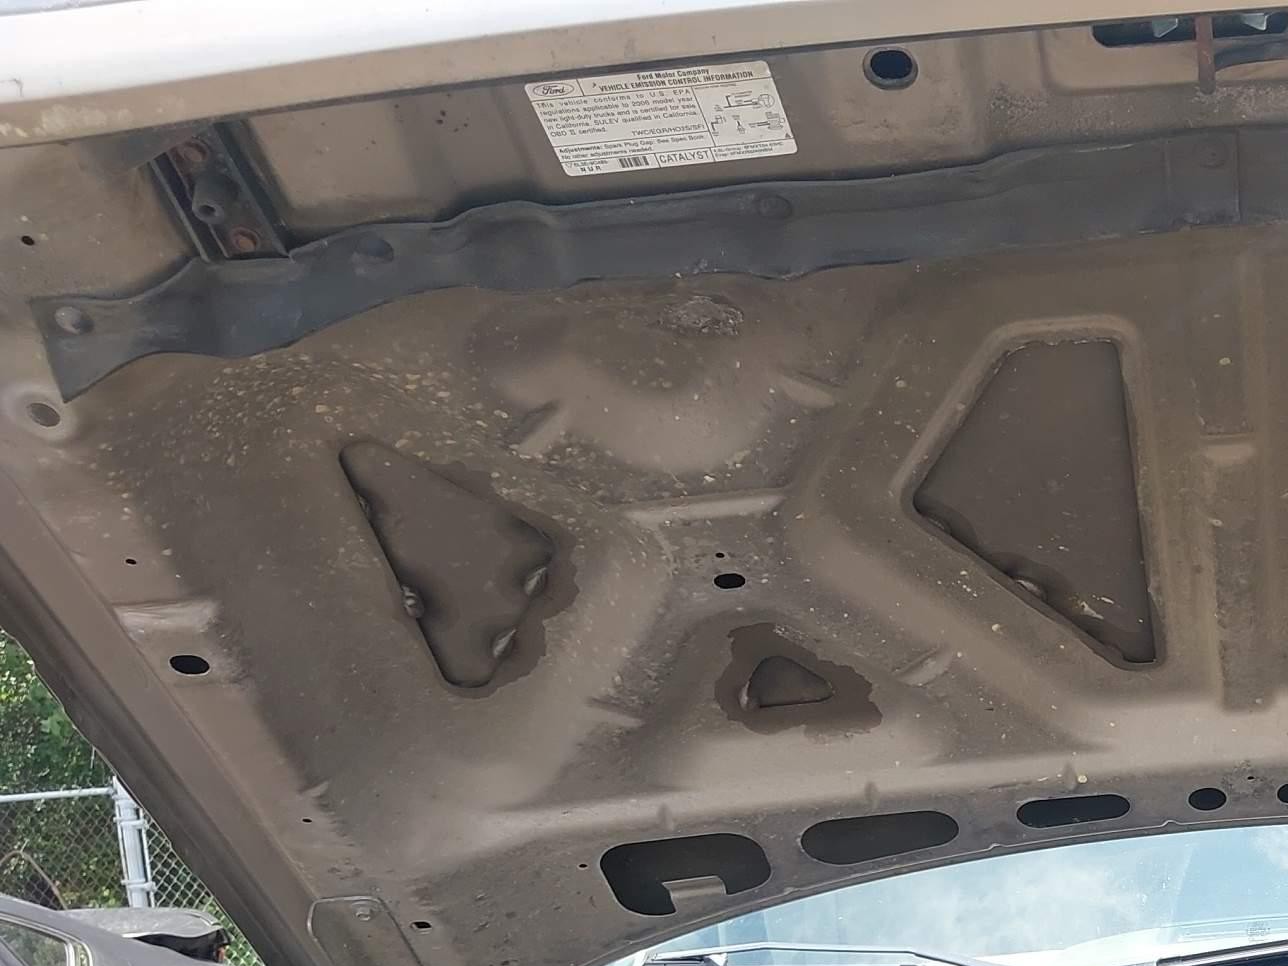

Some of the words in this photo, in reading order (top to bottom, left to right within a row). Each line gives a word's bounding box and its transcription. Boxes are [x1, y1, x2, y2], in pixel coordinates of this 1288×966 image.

[655, 70, 676, 79] Motor
[677, 68, 709, 77] Company
[599, 82, 629, 92] VEHICLE
[631, 79, 667, 89] EMISSION
[668, 76, 702, 86] CONTROL
[703, 71, 754, 83] INFORMATION
[541, 85, 566, 95] Ford
[593, 95, 632, 103] conforms
[540, 107, 581, 117] regulations
[582, 104, 620, 114] applicable
[677, 97, 694, 105] year
[560, 112, 593, 122] light-duty
[640, 105, 669, 113] certified
[593, 118, 620, 126] SULEV
[622, 114, 652, 123] qualified
[550, 130, 568, 138] OBD
[559, 145, 602, 154] Adjustments:
[623, 141, 639, 149] Plug
[590, 149, 628, 158] adjustments
[659, 150, 709, 164] CATALYST
